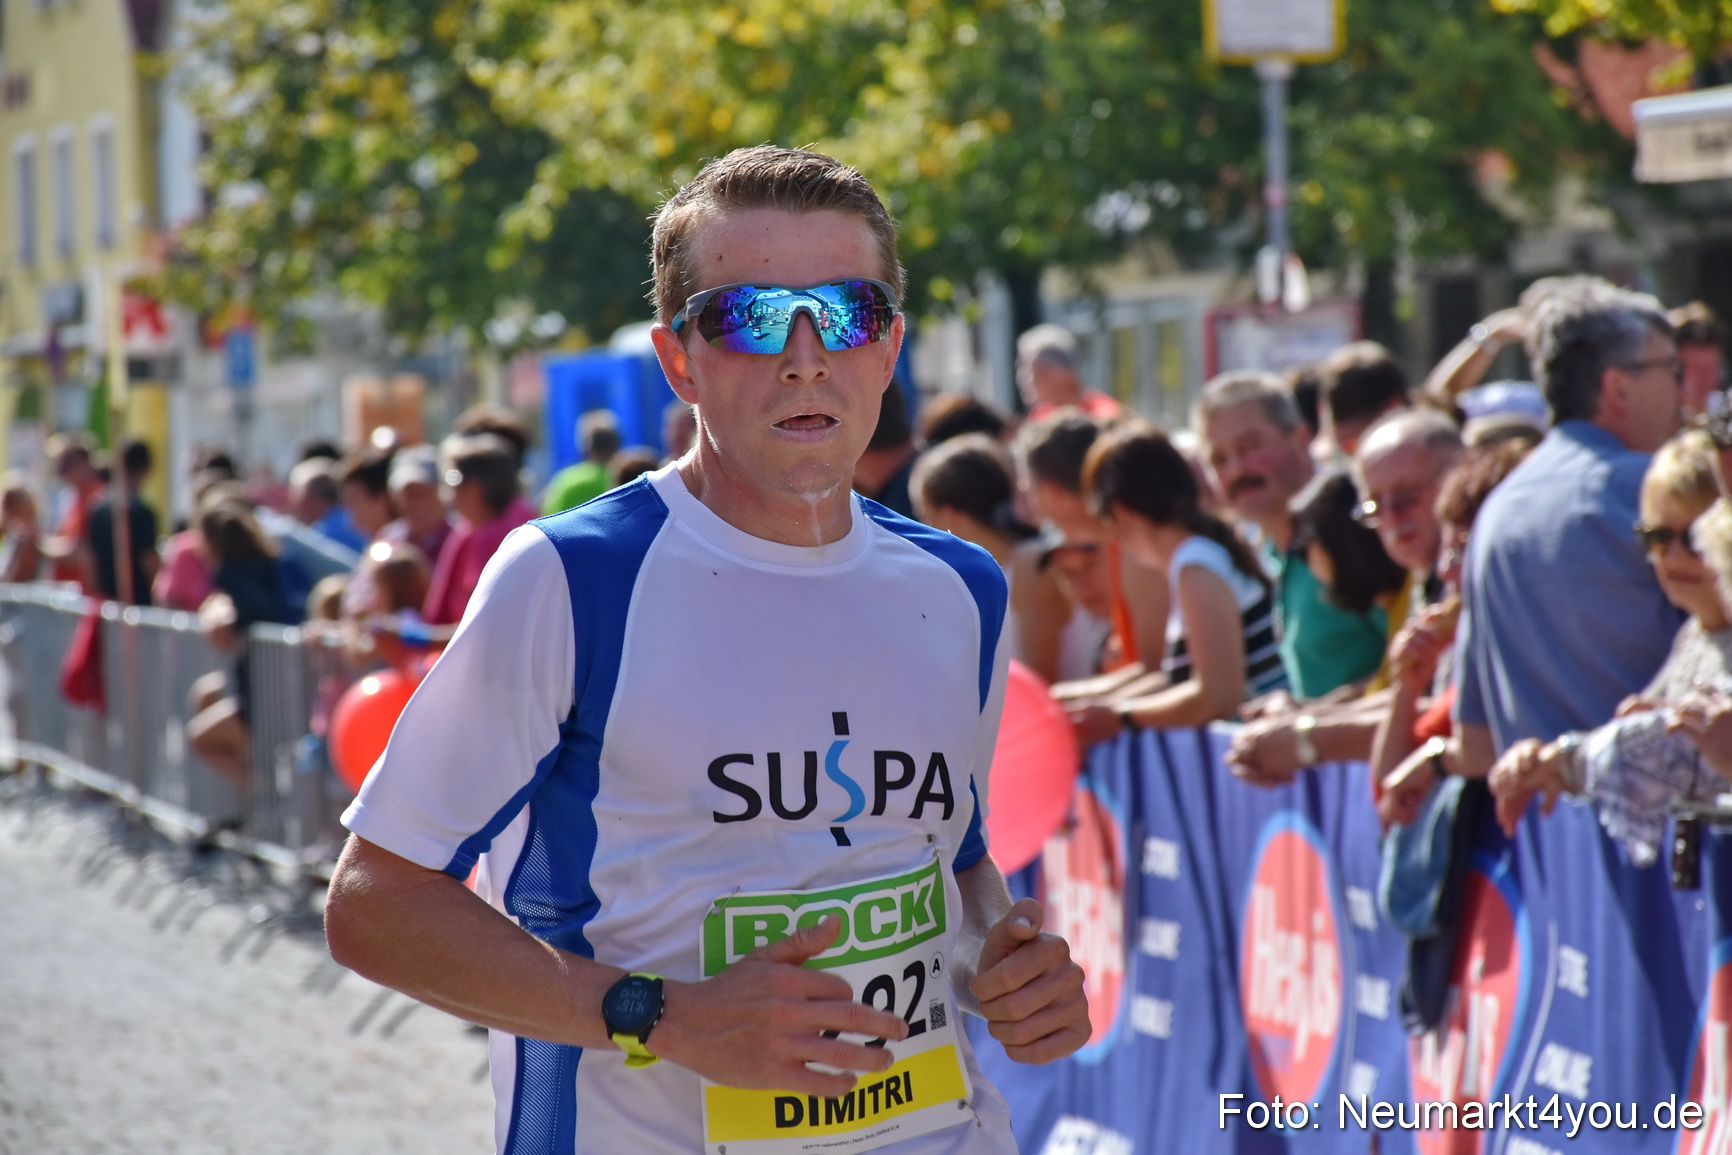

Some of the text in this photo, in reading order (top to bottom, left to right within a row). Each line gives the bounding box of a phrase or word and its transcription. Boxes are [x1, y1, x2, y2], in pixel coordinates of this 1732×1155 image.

[706, 712, 955, 847] SUSPA
[731, 877, 934, 958] BOCK
[931, 958, 941, 974] A
[774, 1071, 914, 1129] DIMITRI
